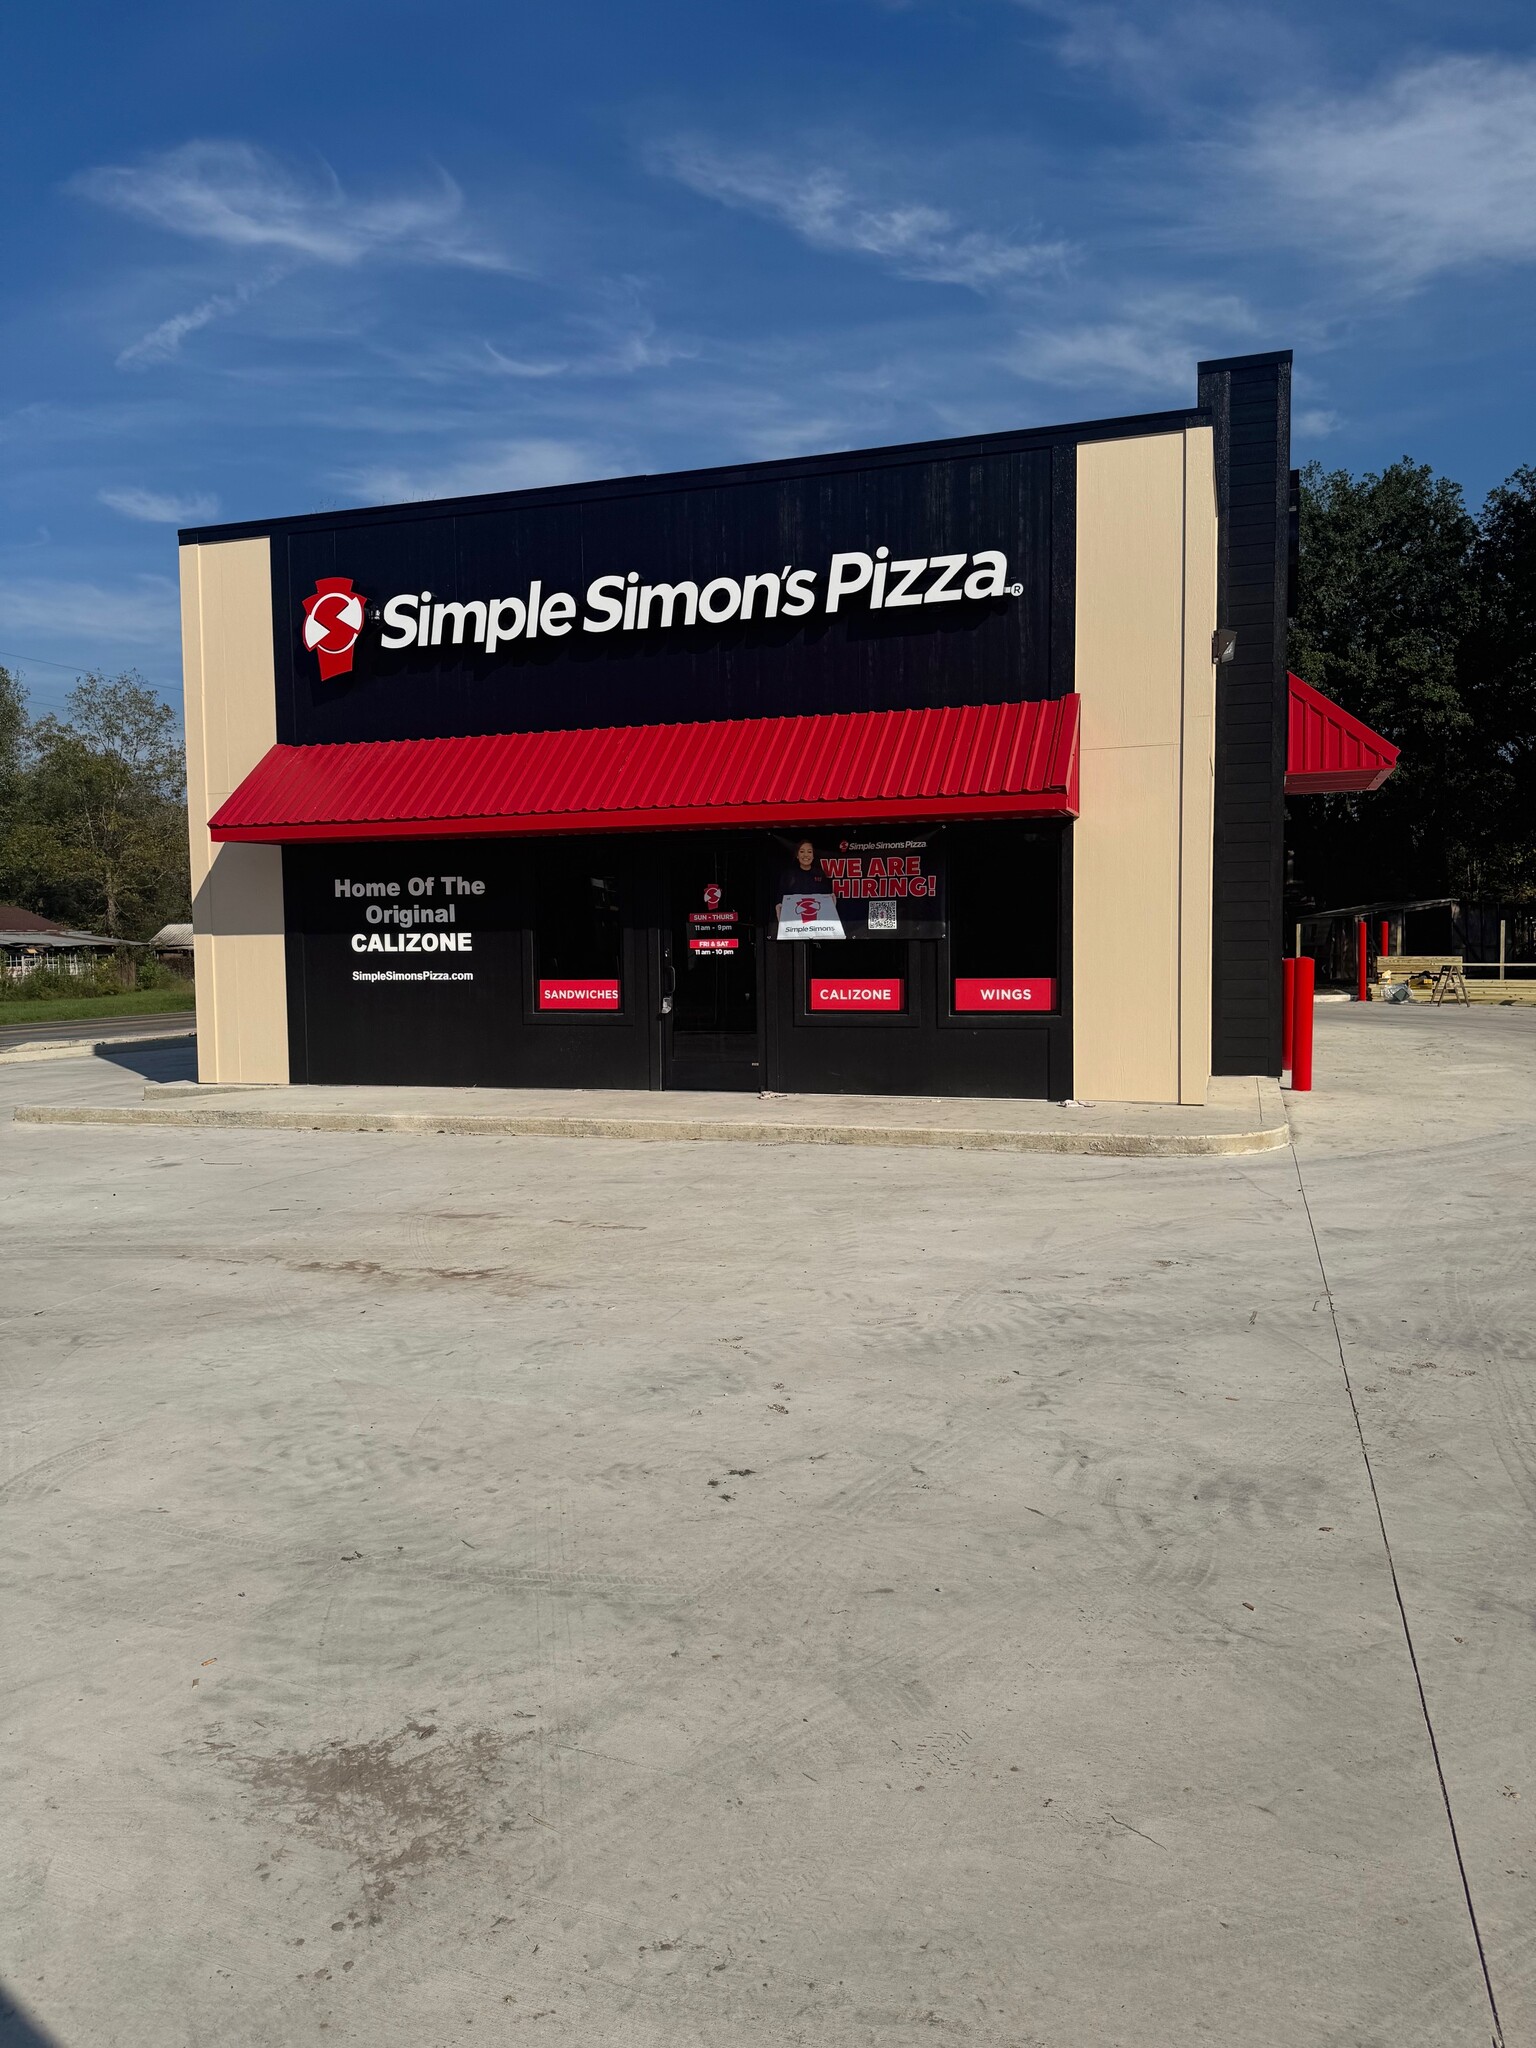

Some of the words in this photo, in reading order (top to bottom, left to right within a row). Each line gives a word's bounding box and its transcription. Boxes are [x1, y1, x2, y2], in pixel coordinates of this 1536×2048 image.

[381, 580, 577, 653] Simple
[583, 565, 817, 633] Simon's
[849, 842, 875, 851] Simple
[905, 840, 927, 849] Pizza
[820, 858, 863, 878] WE
[867, 856, 921, 877] ARE
[334, 878, 401, 898] Home
[407, 877, 435, 897] Of
[440, 876, 486, 896] The
[832, 875, 937, 898] HIRING!
[366, 904, 456, 928] Original
[351, 932, 473, 953] CALIZONE
[352, 970, 474, 983] SimpleSimonsPizza.com
[544, 989, 619, 999] SANDWICHES
[820, 989, 892, 1000] CALIZONE
[980, 988, 1032, 1000] WINGS
